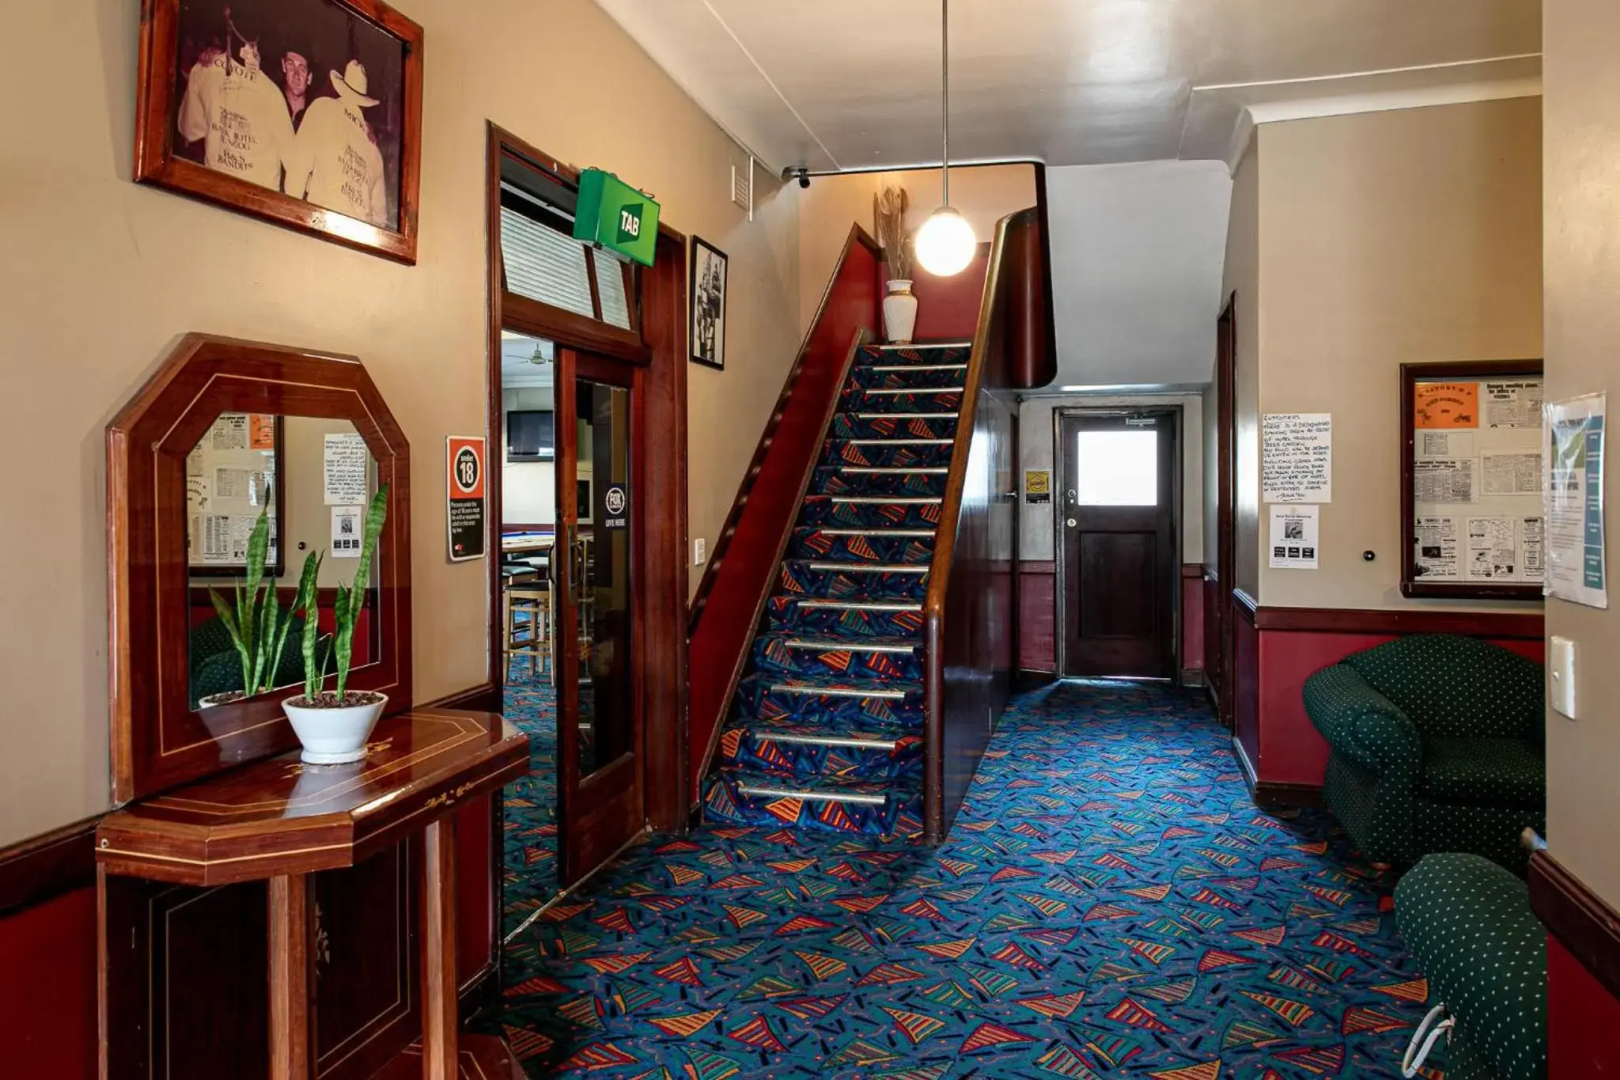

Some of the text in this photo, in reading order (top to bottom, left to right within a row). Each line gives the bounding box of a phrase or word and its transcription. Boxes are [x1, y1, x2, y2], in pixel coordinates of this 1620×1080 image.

[622, 210, 640, 236] TAB
[460, 462, 474, 484] 18
[610, 492, 621, 504] FOX
